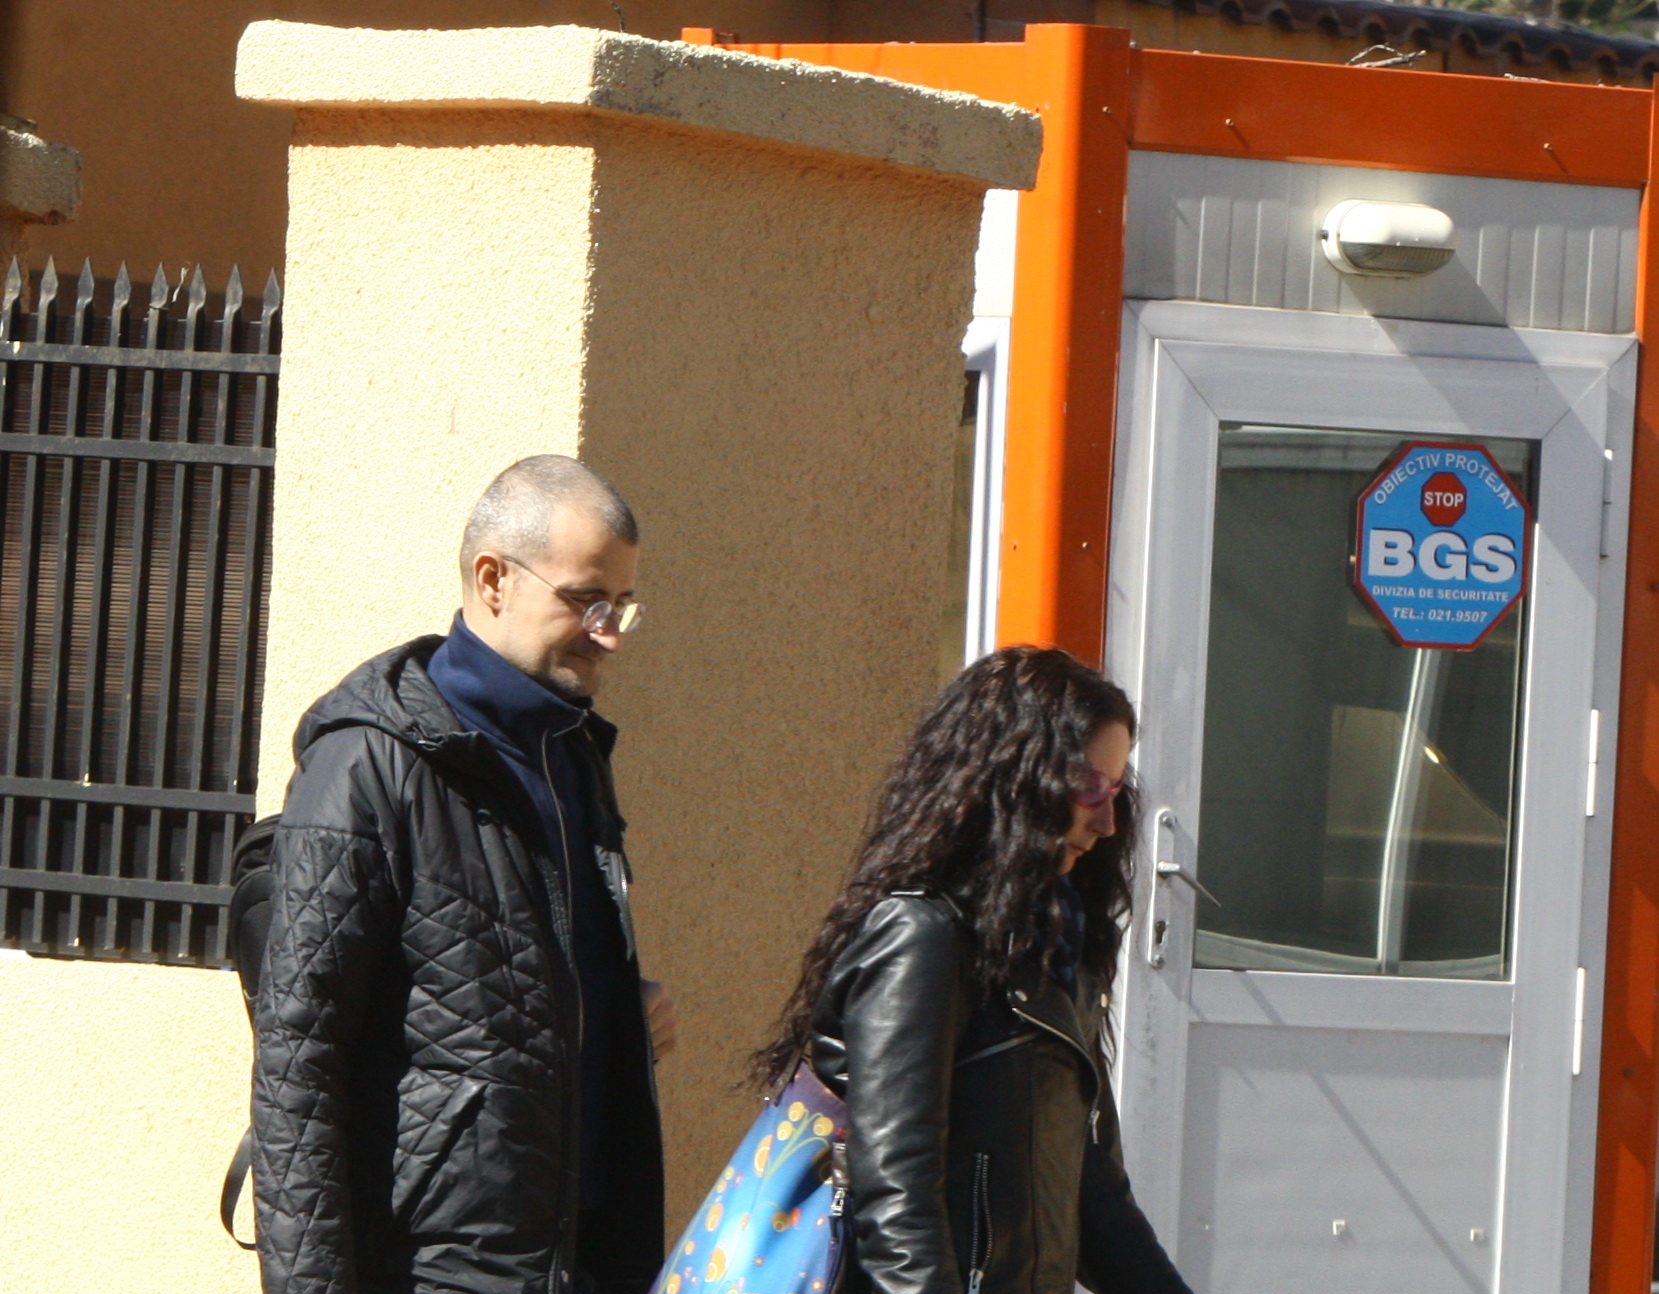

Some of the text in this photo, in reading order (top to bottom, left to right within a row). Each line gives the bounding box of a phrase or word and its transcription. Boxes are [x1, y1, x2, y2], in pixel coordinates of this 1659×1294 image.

[1374, 453, 1518, 511] OBIECTIV PROTEJAT
[1424, 491, 1464, 508] STOP
[1368, 528, 1516, 583] BGS
[1372, 585, 1509, 602] DIVIZIA DE SECURITATE
[1392, 607, 1488, 622] TEL.: 021.9507
